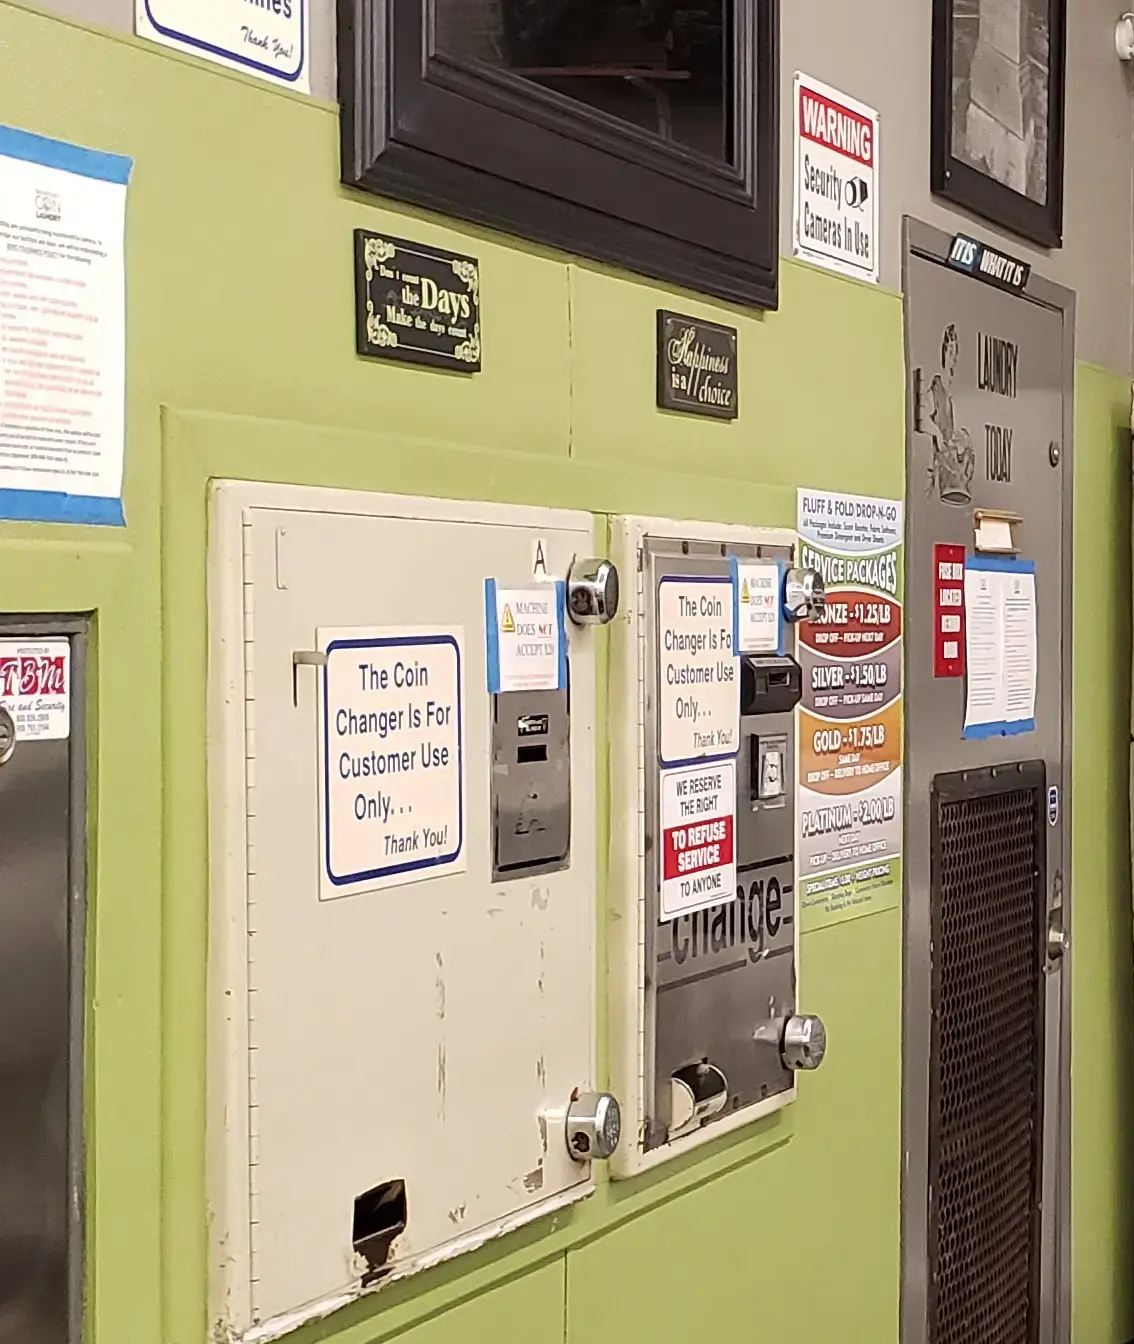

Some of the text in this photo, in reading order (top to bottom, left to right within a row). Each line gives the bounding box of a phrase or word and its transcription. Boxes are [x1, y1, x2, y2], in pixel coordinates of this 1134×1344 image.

[240, 25, 293, 59] Thank You!
[802, 96, 870, 160] WARNING
[804, 154, 842, 210] Security
[804, 202, 869, 258] Cameras In Use
[951, 238, 1024, 286] IT IS WHAT IT IS
[402, 277, 470, 324] the Days
[386, 305, 412, 327] Make
[667, 327, 729, 396] Happiness
[978, 332, 1018, 398] LAUNDRY
[681, 375, 687, 389] a
[699, 375, 731, 405] choice
[985, 424, 1013, 483] TODAY
[803, 497, 825, 514] FLUFF
[835, 500, 854, 516] FOLD
[534, 540, 546, 574] A
[846, 551, 897, 595] PACKAGES
[516, 602, 548, 614] MACHINE
[678, 596, 722, 617] The Coin
[855, 604, 891, 624] $1.25/LB
[517, 623, 535, 636] DOES
[665, 629, 732, 655] Changer Is Fo
[516, 644, 542, 656] ACCEPT
[359, 660, 428, 691] The Coin
[667, 661, 734, 685] Customer Use
[812, 667, 844, 688] SILVER
[851, 664, 887, 685] $1.50/LB
[336, 701, 451, 739] Changer Is For
[693, 729, 733, 748] Thank You!
[814, 729, 841, 752] GOLD
[848, 724, 885, 747] $1.75/LB
[339, 742, 449, 780] Customer Use
[676, 775, 722, 796] WE RESERVE
[680, 795, 718, 817] THE RIGHT
[803, 803, 852, 835] PLATINUM
[384, 825, 448, 856] Thank You!
[671, 821, 726, 851] TO REFUSE
[678, 844, 720, 872] SERVICE
[680, 873, 722, 898] TO ANYONE
